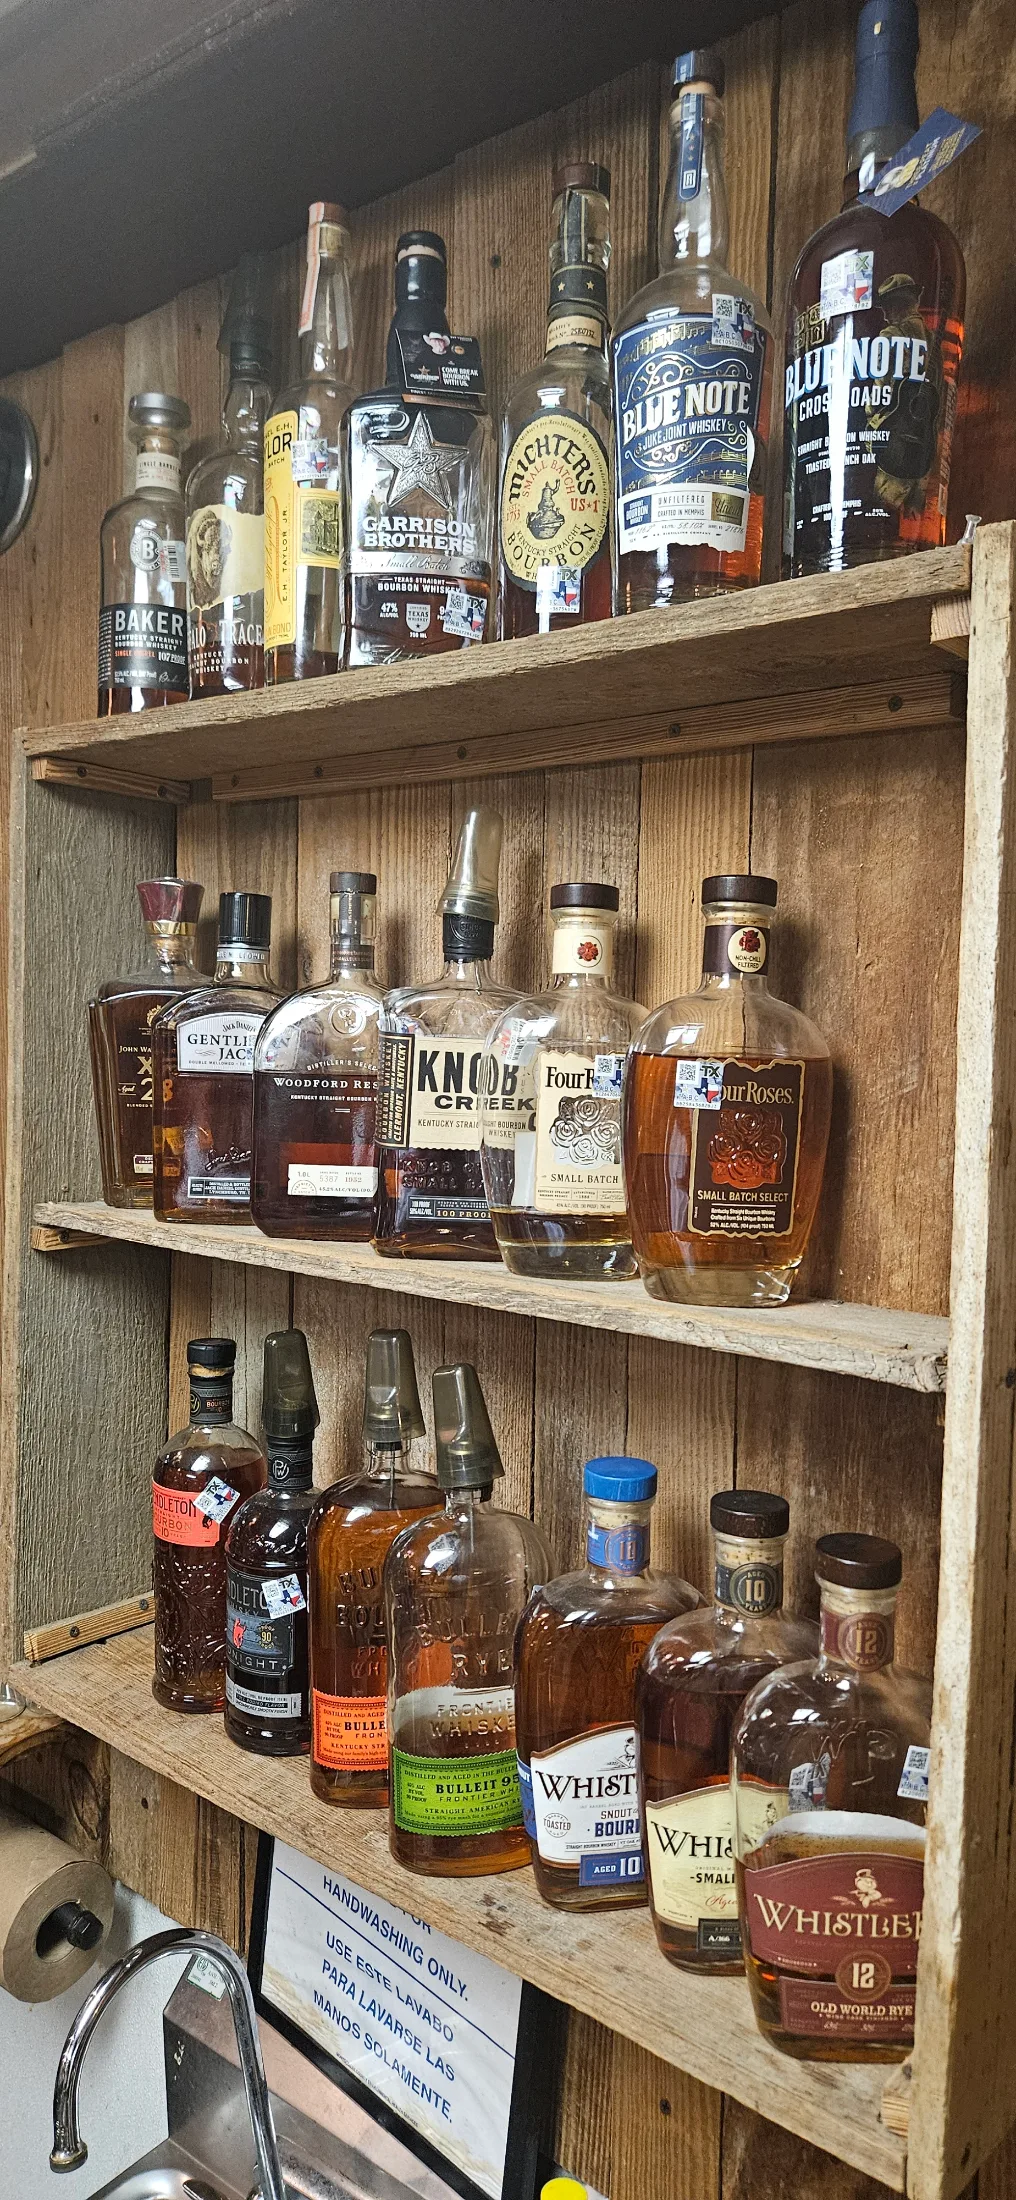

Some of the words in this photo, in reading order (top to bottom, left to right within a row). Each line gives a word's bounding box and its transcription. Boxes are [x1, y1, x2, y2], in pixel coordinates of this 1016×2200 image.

[784, 348, 835, 408] BLUE
[850, 336, 927, 382] NOTE
[799, 385, 892, 422] CROSOADS
[622, 387, 681, 447] BLUE
[683, 381, 750, 419] NOTE
[276, 423, 293, 434] E.H.
[642, 433, 663, 451] JUKE
[663, 425, 687, 441] JOINT
[688, 418, 727, 436] WHISKEY
[859, 430, 891, 442] WHISKEY
[264, 431, 293, 462] LOR
[797, 437, 823, 457] STRAIGHT
[268, 457, 285, 469] BATCH
[862, 453, 876, 464] OAK
[509, 433, 596, 505] MICHTER'S
[522, 459, 547, 498] SMALL
[551, 459, 576, 495] BATCH
[658, 495, 705, 505] UNFILTERED
[626, 505, 648, 521] BOURBON
[658, 509, 676, 518] CRAFTED
[362, 516, 476, 538] GARRISON
[363, 531, 477, 557] BROTHERS
[507, 522, 596, 570] BOURBON
[517, 529, 547, 557] KENTUCKY
[548, 523, 581, 555] STRAIGHT
[381, 554, 415, 569] Small
[415, 577, 445, 585] STRAIGHT
[557, 567, 578, 582] TX
[378, 583, 419, 592] BOURBON
[423, 584, 460, 595] WHISKEY
[381, 602, 398, 613] 47%
[466, 596, 483, 609] TX
[408, 610, 429, 618] TEXAS
[115, 610, 184, 638] BAKER
[115, 635, 147, 643] KENTUCKY
[150, 636, 183, 646] STRAIGHT
[218, 620, 263, 647] TRACE
[146, 641, 177, 651] WHISKEY
[158, 651, 170, 662] 107
[119, 1045, 139, 1054] JOHN
[219, 1047, 247, 1061] JAC
[307, 1060, 351, 1071] DISTILLER'S
[383, 1041, 392, 1087] WHISKEY
[396, 1042, 407, 1090] KENTUCKY
[700, 1065, 720, 1078] TX
[273, 1077, 348, 1089] WOODFORD
[545, 1066, 585, 1089] Four
[719, 1084, 746, 1102] our
[382, 1092, 390, 1140] BOURBON
[393, 1093, 405, 1142] CLERMONT,
[417, 1118, 454, 1128] KENTUCKY
[497, 1120, 526, 1130] BOURBON
[319, 1175, 338, 1183] 5387
[550, 1173, 584, 1183] SMALL
[587, 1174, 619, 1184] BATCH
[697, 1189, 727, 1201] SMALL
[729, 1191, 757, 1202] BATCH
[760, 1193, 789, 1202] SELECT
[729, 1208, 744, 1216] Straight
[206, 1480, 221, 1495] TX
[161, 1526, 169, 1538] 10
[620, 1541, 636, 1561] 10
[279, 1577, 294, 1589] TX
[746, 1579, 765, 1602] 10
[260, 1631, 272, 1643] 90
[856, 1629, 877, 1654] 12
[323, 1709, 351, 1718] DISTILLED
[437, 1697, 515, 1718] FRONTIE
[429, 1713, 517, 1737] WHISKE
[404, 1770, 436, 1780] DISTILLED
[482, 1770, 496, 1778] THE
[436, 1779, 497, 1795] BULLEIT
[501, 1774, 520, 1787] 95
[535, 1771, 636, 1803] WHIST
[439, 1792, 496, 1803] FRONTIER
[425, 1807, 466, 1815] STRAIGHT
[469, 1801, 509, 1813] AMERICAN
[600, 1808, 632, 1820] SNOUT
[543, 1819, 572, 1831] TOASTED
[595, 1819, 641, 1838] BOUR
[594, 1865, 616, 1874] AGED
[619, 1856, 641, 1877] 10
[754, 1893, 925, 1942] WHISTLE
[323, 1875, 423, 1966] HANDWASHING
[428, 1956, 469, 2002] ONLY.
[852, 1962, 875, 1989] 12
[325, 1930, 353, 1964] USE
[356, 1955, 392, 1990] ESTE
[395, 1984, 454, 2043] LAVABO
[811, 2001, 837, 2013] OLD
[840, 2002, 886, 2016] WORLD
[888, 2005, 913, 2016] RYE
[322, 1958, 356, 2000] PARA
[358, 1990, 422, 2055] LAVARSE
[426, 2044, 456, 2083] LAS
[313, 1989, 361, 2039] MANOS
[363, 2032, 454, 2124] SOLAMENTE.
